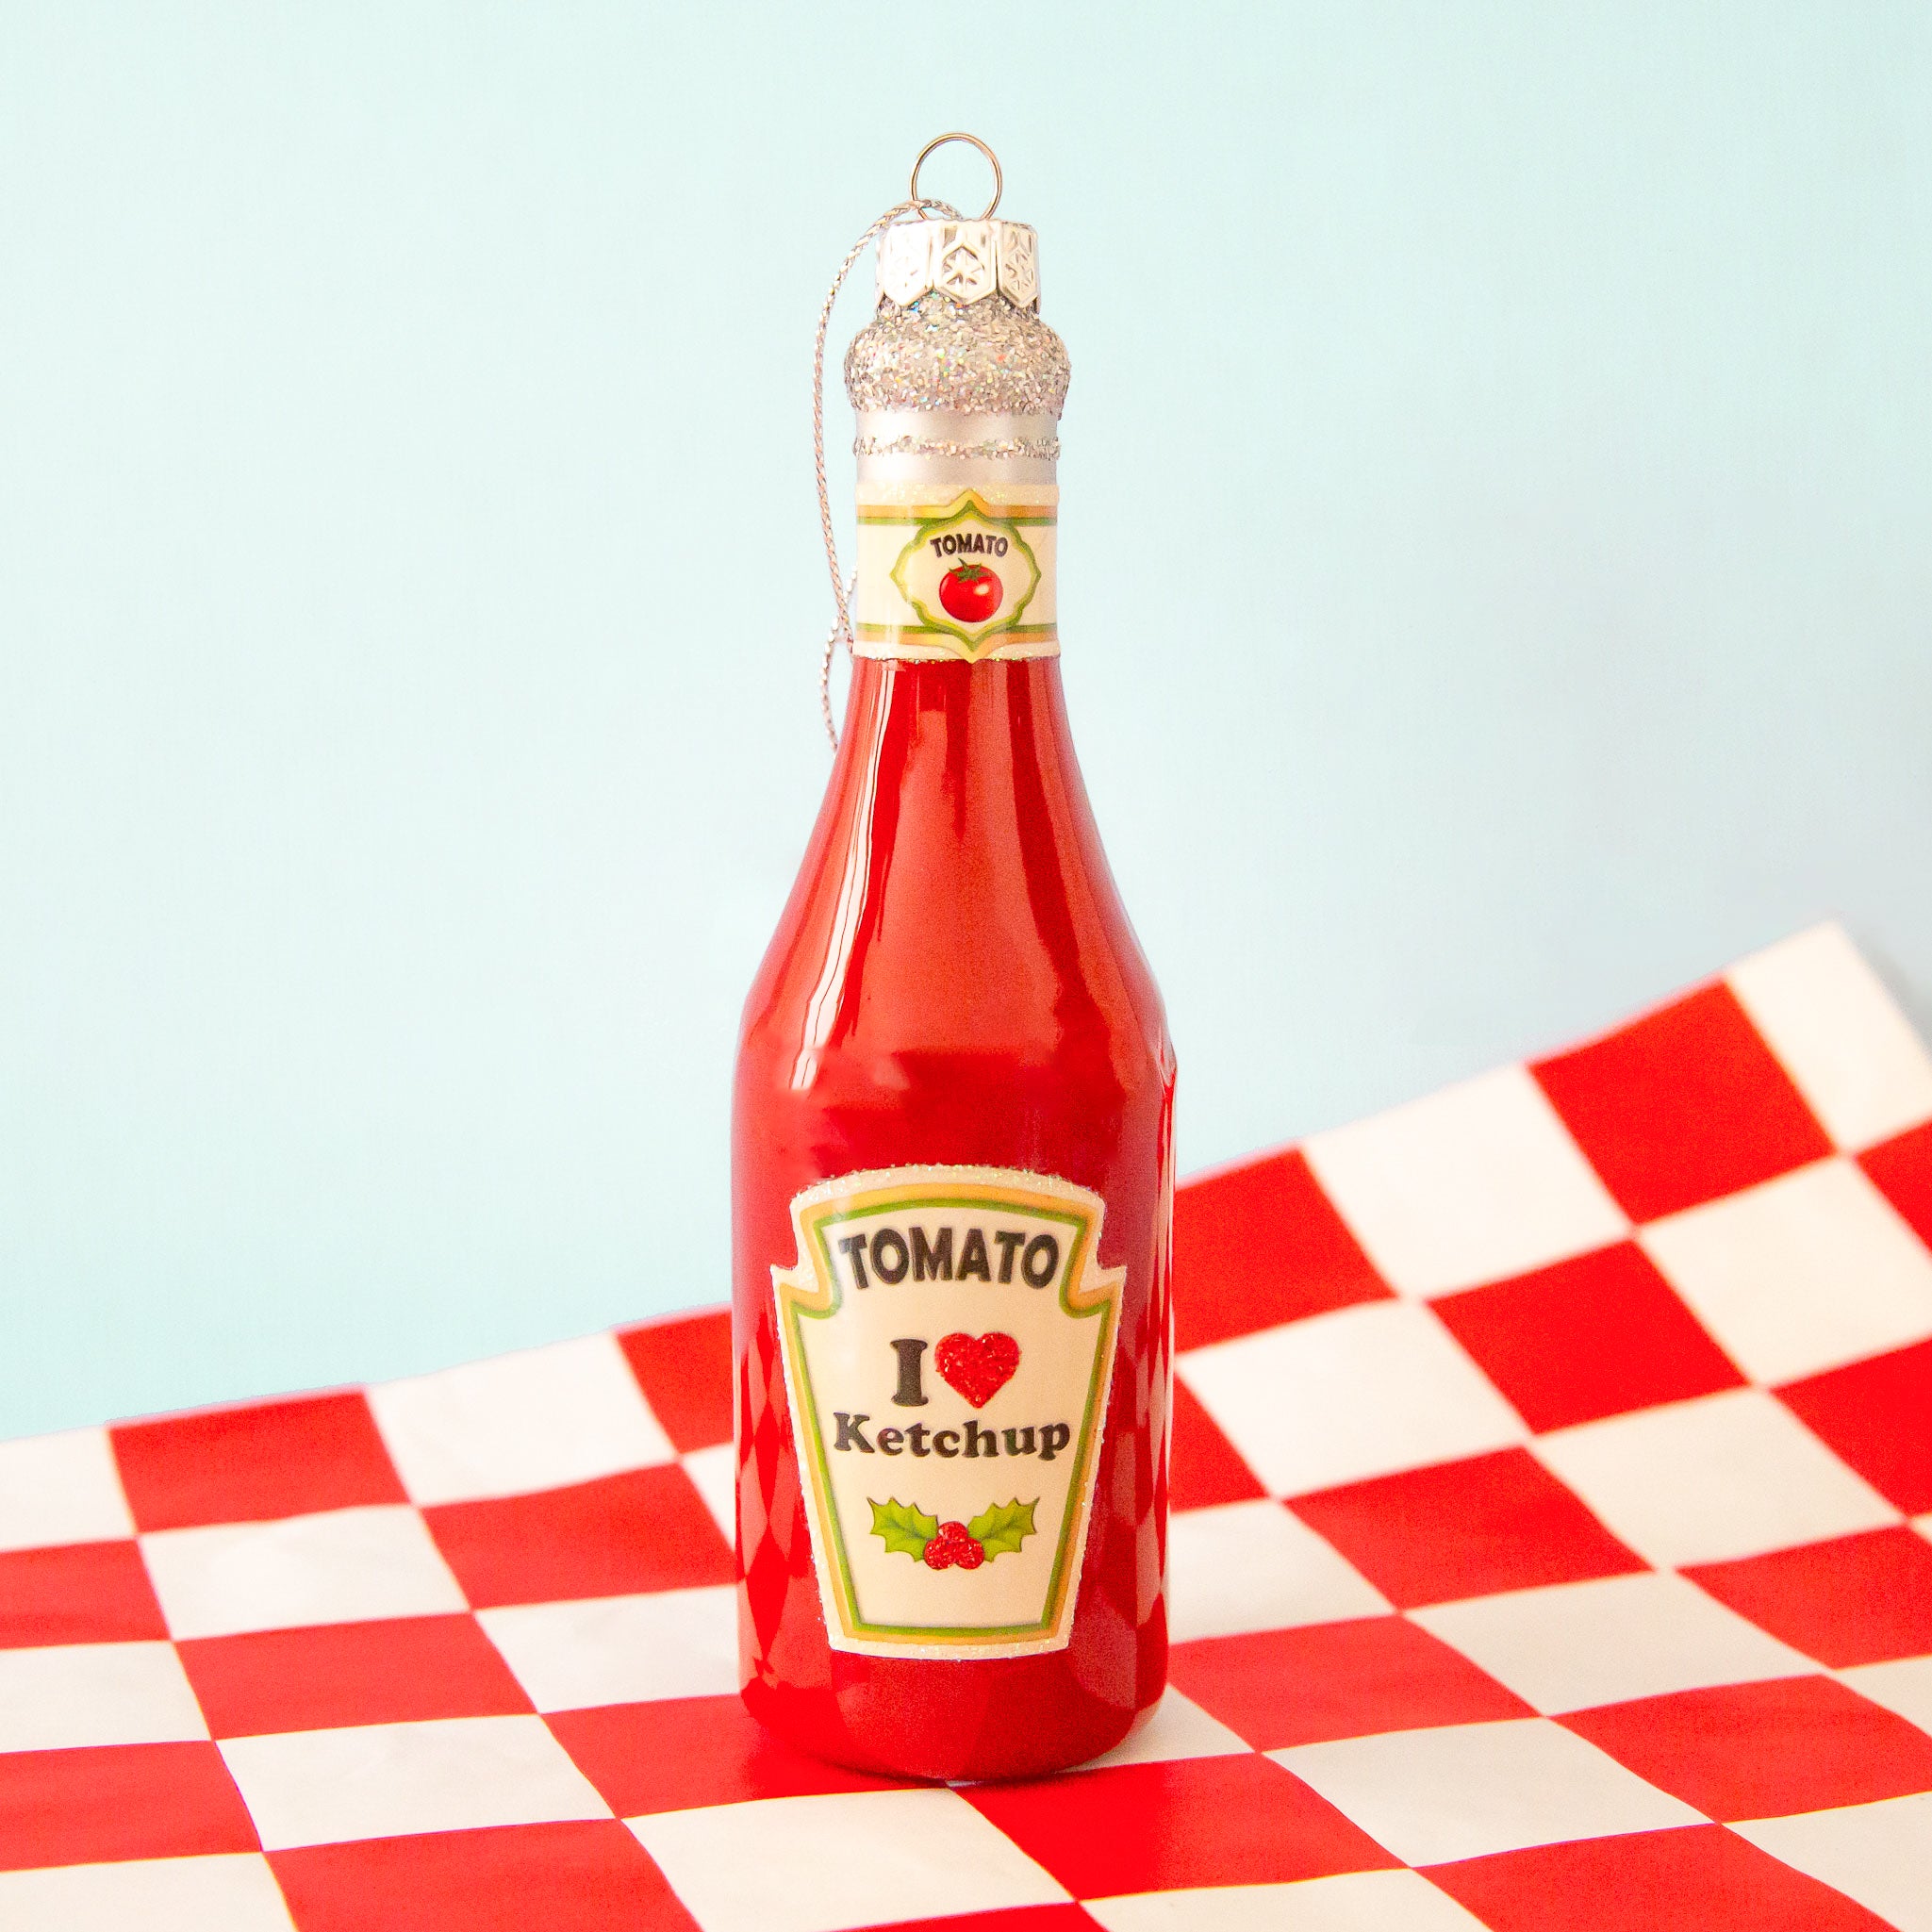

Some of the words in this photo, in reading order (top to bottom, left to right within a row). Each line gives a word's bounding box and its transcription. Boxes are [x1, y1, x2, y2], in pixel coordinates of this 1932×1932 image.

[930, 533, 1009, 557] TOMATO
[838, 1227, 1060, 1290] TOMATO
[890, 1338, 929, 1407] I
[833, 1412, 1071, 1461] Ketchup
